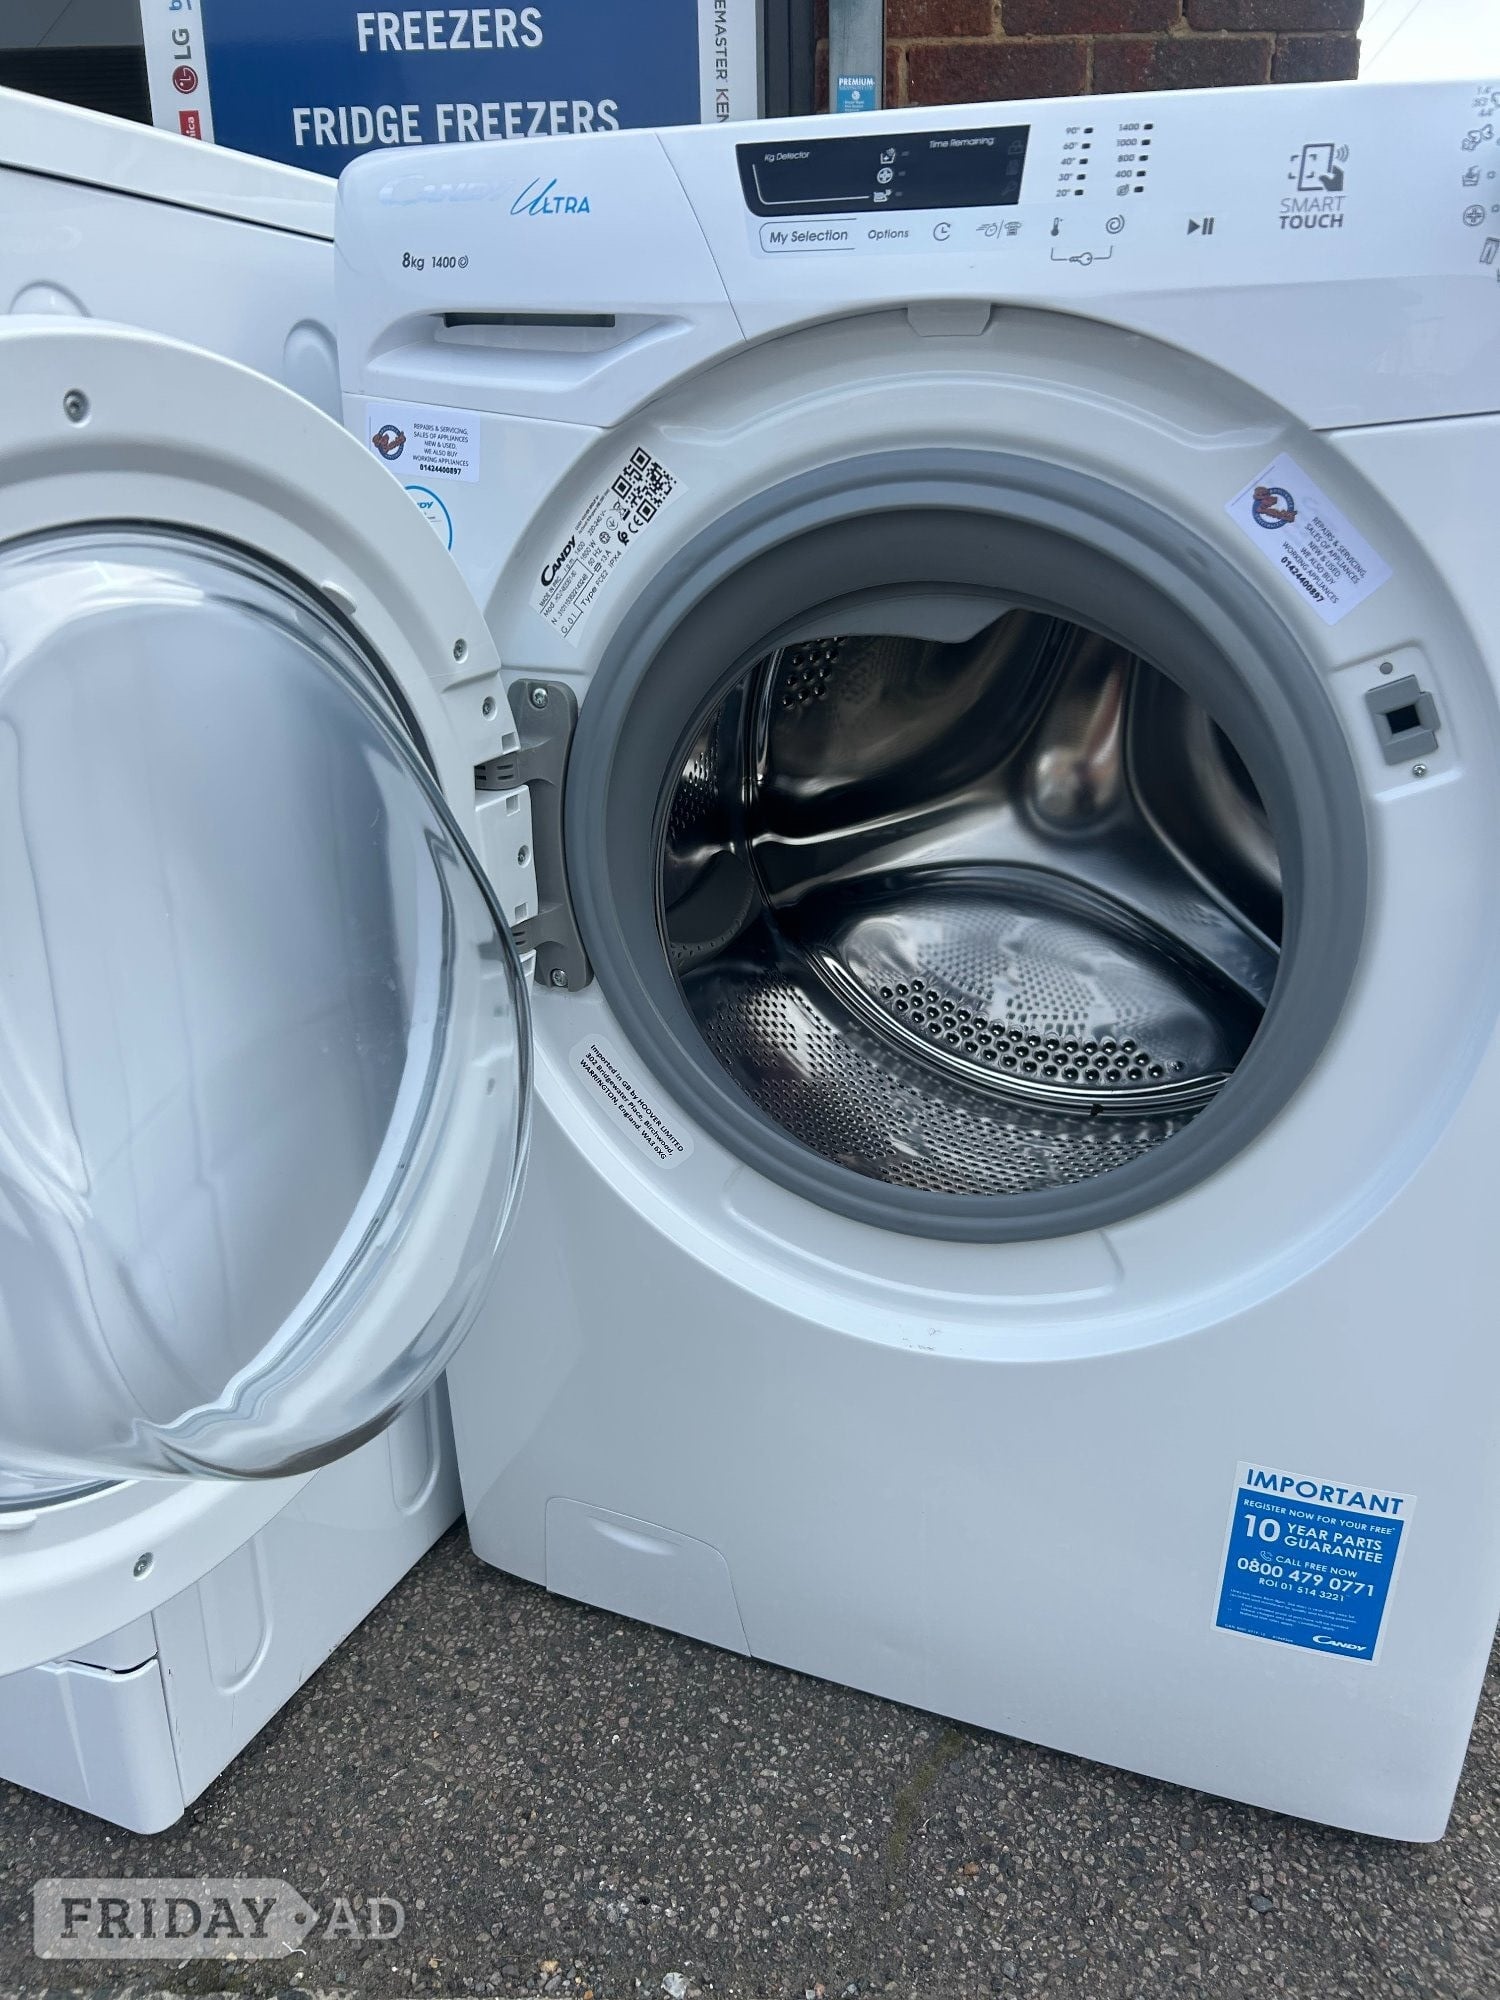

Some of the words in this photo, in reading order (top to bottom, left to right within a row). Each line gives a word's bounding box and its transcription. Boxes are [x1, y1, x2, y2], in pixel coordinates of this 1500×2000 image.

[356, 6, 544, 52] FREEZERS
[171, 28, 192, 60] LG
[838, 77, 874, 86] PREMIUM
[292, 104, 422, 146] FRIDGE
[436, 99, 620, 143] FREEZERS
[1118, 123, 1140, 132] 1400
[929, 139, 949, 149] Time
[950, 136, 995, 148] Remaining
[1115, 138, 1138, 147] 1000
[764, 153, 775, 163] Kg
[776, 150, 810, 162] Detector
[1115, 169, 1132, 178] 400
[509, 177, 591, 216] ULTRA
[1279, 195, 1347, 214] SMART
[1278, 213, 1345, 230] TOUCH
[769, 231, 789, 245] My
[790, 229, 848, 243] Selection
[867, 229, 909, 241] Options
[401, 252, 425, 271] 8kg
[431, 256, 457, 269] 1400
[413, 423, 435, 431] REPAIRS
[413, 431, 429, 439] SALES
[437, 434, 469, 443] APPLIANCES
[412, 455, 438, 464] WORKING
[438, 457, 469, 467] APPLIANCES
[433, 449, 447, 457] ALSO
[447, 450, 458, 458] BUY
[1312, 516, 1336, 541] REPAIRS
[588, 539, 597, 549] W
[592, 547, 602, 558] Hz
[1304, 523, 1322, 543] SALES
[1320, 540, 1331, 550] OF
[1327, 549, 1361, 584] APPLIANCES
[1308, 540, 1323, 556] NEW
[541, 534, 576, 587] CANDY
[600, 554, 608, 563] 13
[1300, 546, 1312, 558] WE
[1309, 557, 1325, 574] ALSO
[1321, 571, 1336, 585] BUY
[580, 586, 598, 607] Type
[607, 550, 622, 568] IPX4
[1280, 556, 1324, 603] 01424400897
[1282, 541, 1309, 571] WORKING
[1306, 569, 1339, 604] APPLIANCES
[539, 592, 551, 607] MADE
[580, 1059, 619, 1106] WARRINGTON,
[641, 1129, 656, 1147] WA3
[653, 1145, 667, 1160] 6XG
[585, 1052, 598, 1066] 302
[596, 1064, 629, 1102] Bridgewater
[627, 1101, 644, 1122] Place,
[643, 1120, 674, 1156] Birchwood,
[590, 1044, 618, 1075] Imported
[621, 1080, 632, 1091] GB
[629, 1089, 639, 1101] by
[637, 1098, 662, 1127] HOOVER
[660, 1125, 684, 1152] LIMITED
[1246, 1468, 1404, 1515] IMPORTANT
[1243, 1498, 1287, 1515] REGISTER
[1288, 1508, 1315, 1521] NOW
[1316, 1514, 1337, 1525] FOR
[1339, 1519, 1367, 1531] YOUR
[1244, 1513, 1281, 1543] 10
[1287, 1522, 1329, 1541] YEAR
[1333, 1531, 1383, 1551] PARTS
[1283, 1535, 1384, 1564] GUARANTEE
[1237, 1557, 1283, 1578] 0800
[1288, 1569, 1324, 1587] 479
[1329, 1577, 1376, 1598] 0771
[1275, 1555, 1302, 1568] CALL
[1304, 1561, 1328, 1573] FREE
[1330, 1566, 1358, 1579] NOW
[1258, 1577, 1278, 1588] ROI
[1280, 1581, 1293, 1592] 01
[1296, 1586, 1317, 1598] 514
[1319, 1589, 1345, 1603] 3221
[1312, 1634, 1368, 1652] CANDY
